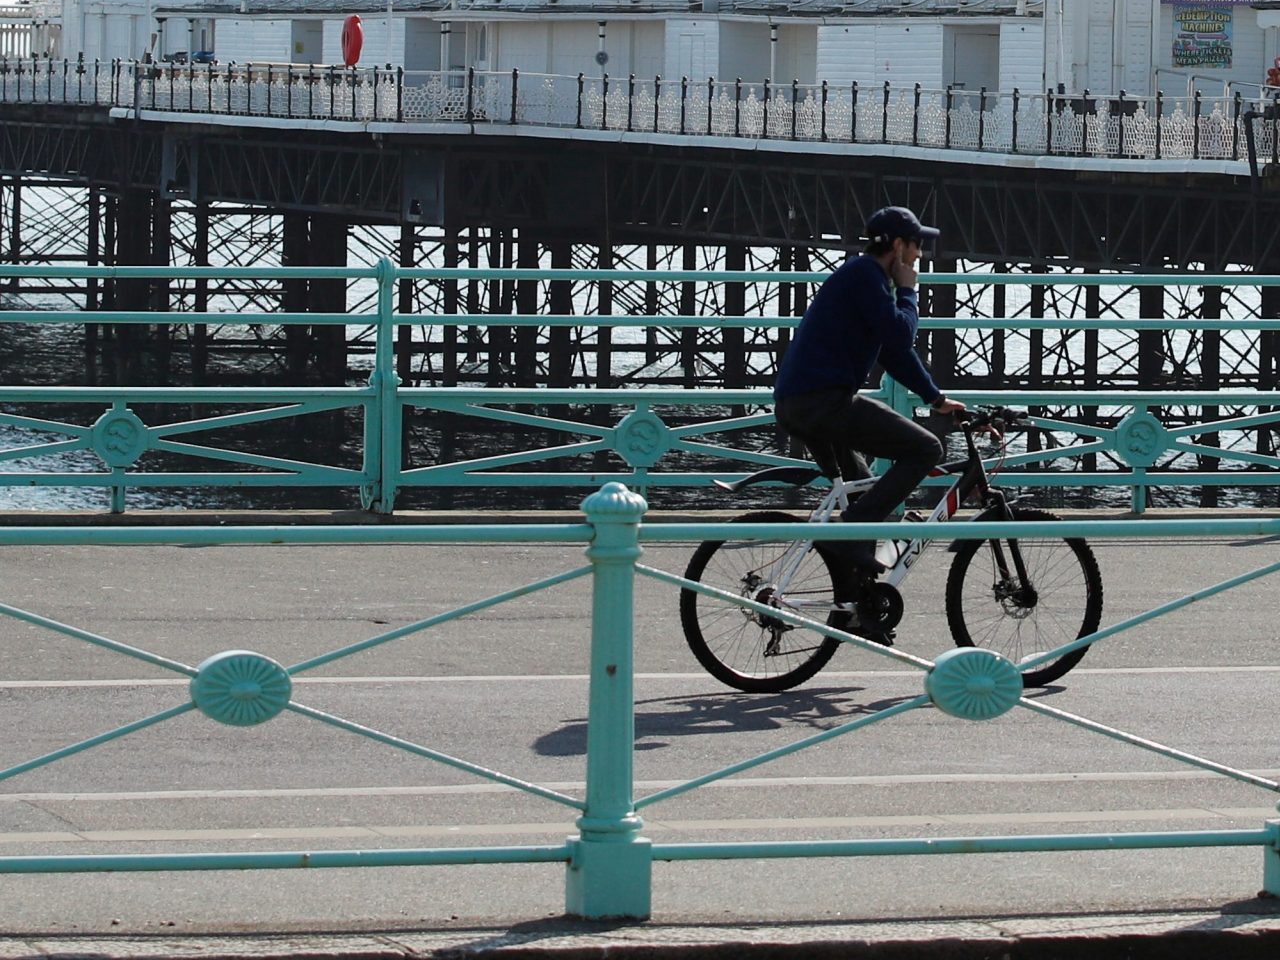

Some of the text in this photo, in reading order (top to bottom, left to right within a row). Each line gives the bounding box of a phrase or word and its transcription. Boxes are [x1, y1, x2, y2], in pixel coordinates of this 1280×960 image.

[1175, 11, 1231, 22] REDEMPTION
[1182, 22, 1225, 32] MACHINES
[1176, 57, 1198, 65] MEAN
